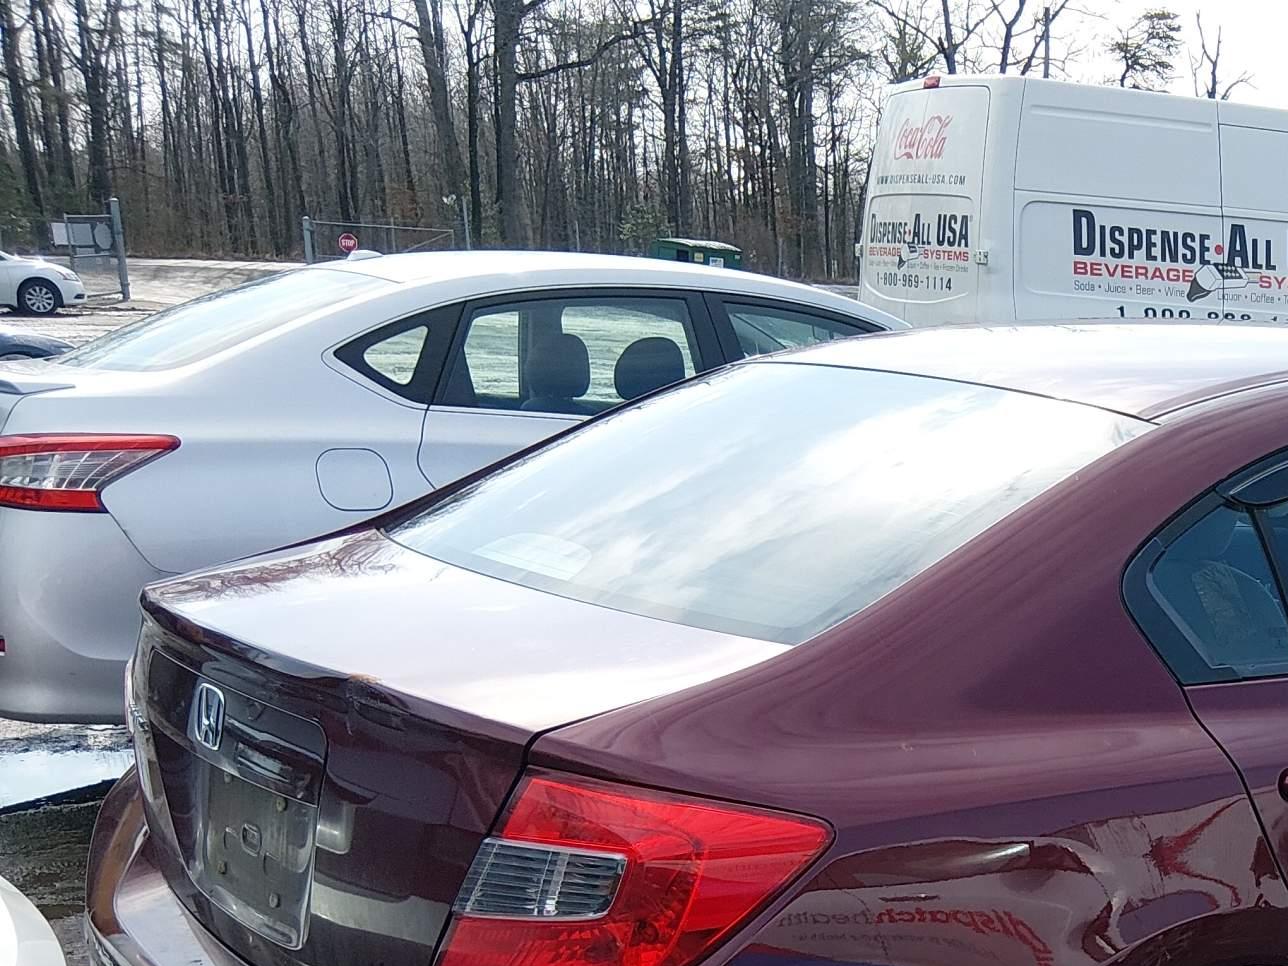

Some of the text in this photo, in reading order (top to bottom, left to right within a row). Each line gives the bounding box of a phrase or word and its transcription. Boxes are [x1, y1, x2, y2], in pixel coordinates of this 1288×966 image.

[341, 239, 355, 247] STOP
[923, 249, 969, 262] SYSTEMS
[877, 272, 952, 291] 1-800-969-1114
[1073, 261, 1194, 283] BEVERAGE
[1074, 280, 1095, 291] Soda
[1104, 282, 1127, 293] Juice
[1136, 285, 1155, 295] Beer
[1165, 286, 1186, 298] Wine
[1217, 290, 1242, 302] Liquor
[1250, 292, 1275, 304] Coffee
